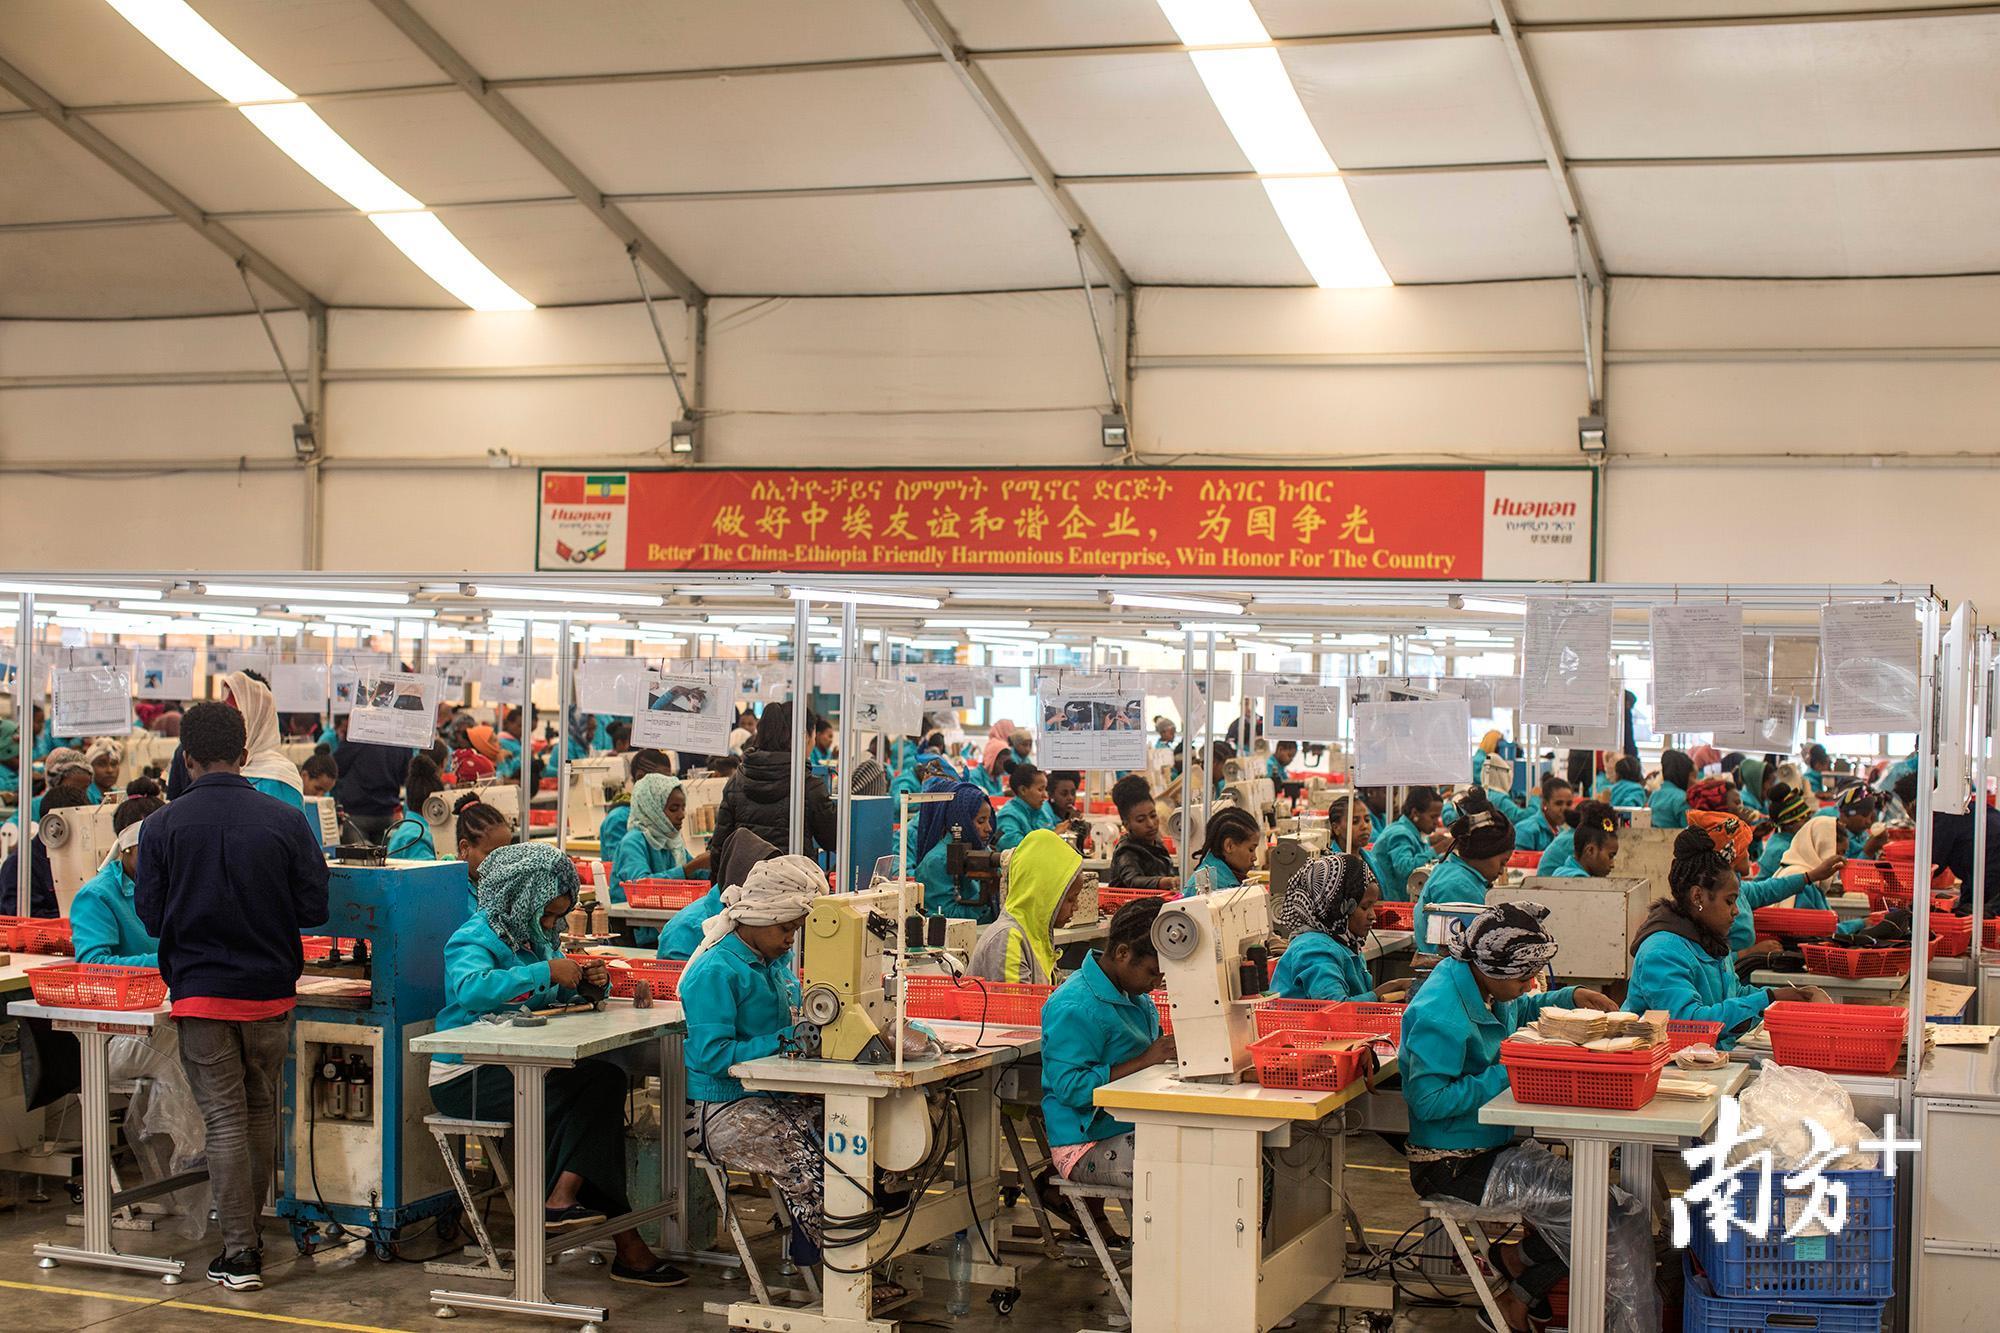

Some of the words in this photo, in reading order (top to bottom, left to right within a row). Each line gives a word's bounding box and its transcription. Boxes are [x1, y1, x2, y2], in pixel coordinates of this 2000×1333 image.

[1278, 479, 1335, 503] ክብር
[1491, 498, 1576, 518] Huajian
[648, 543, 695, 561] Better
[700, 543, 733, 561] The
[737, 543, 868, 568] China-Ethiopia
[872, 545, 946, 568] Friendly
[951, 546, 1064, 565] Harmonious
[1069, 546, 1172, 570] Enterprise,
[1176, 547, 1216, 567] Win
[1222, 548, 1284, 567] Honor
[1289, 548, 1325, 568] For
[1328, 548, 1368, 569] The
[1372, 549, 1456, 575] Country
